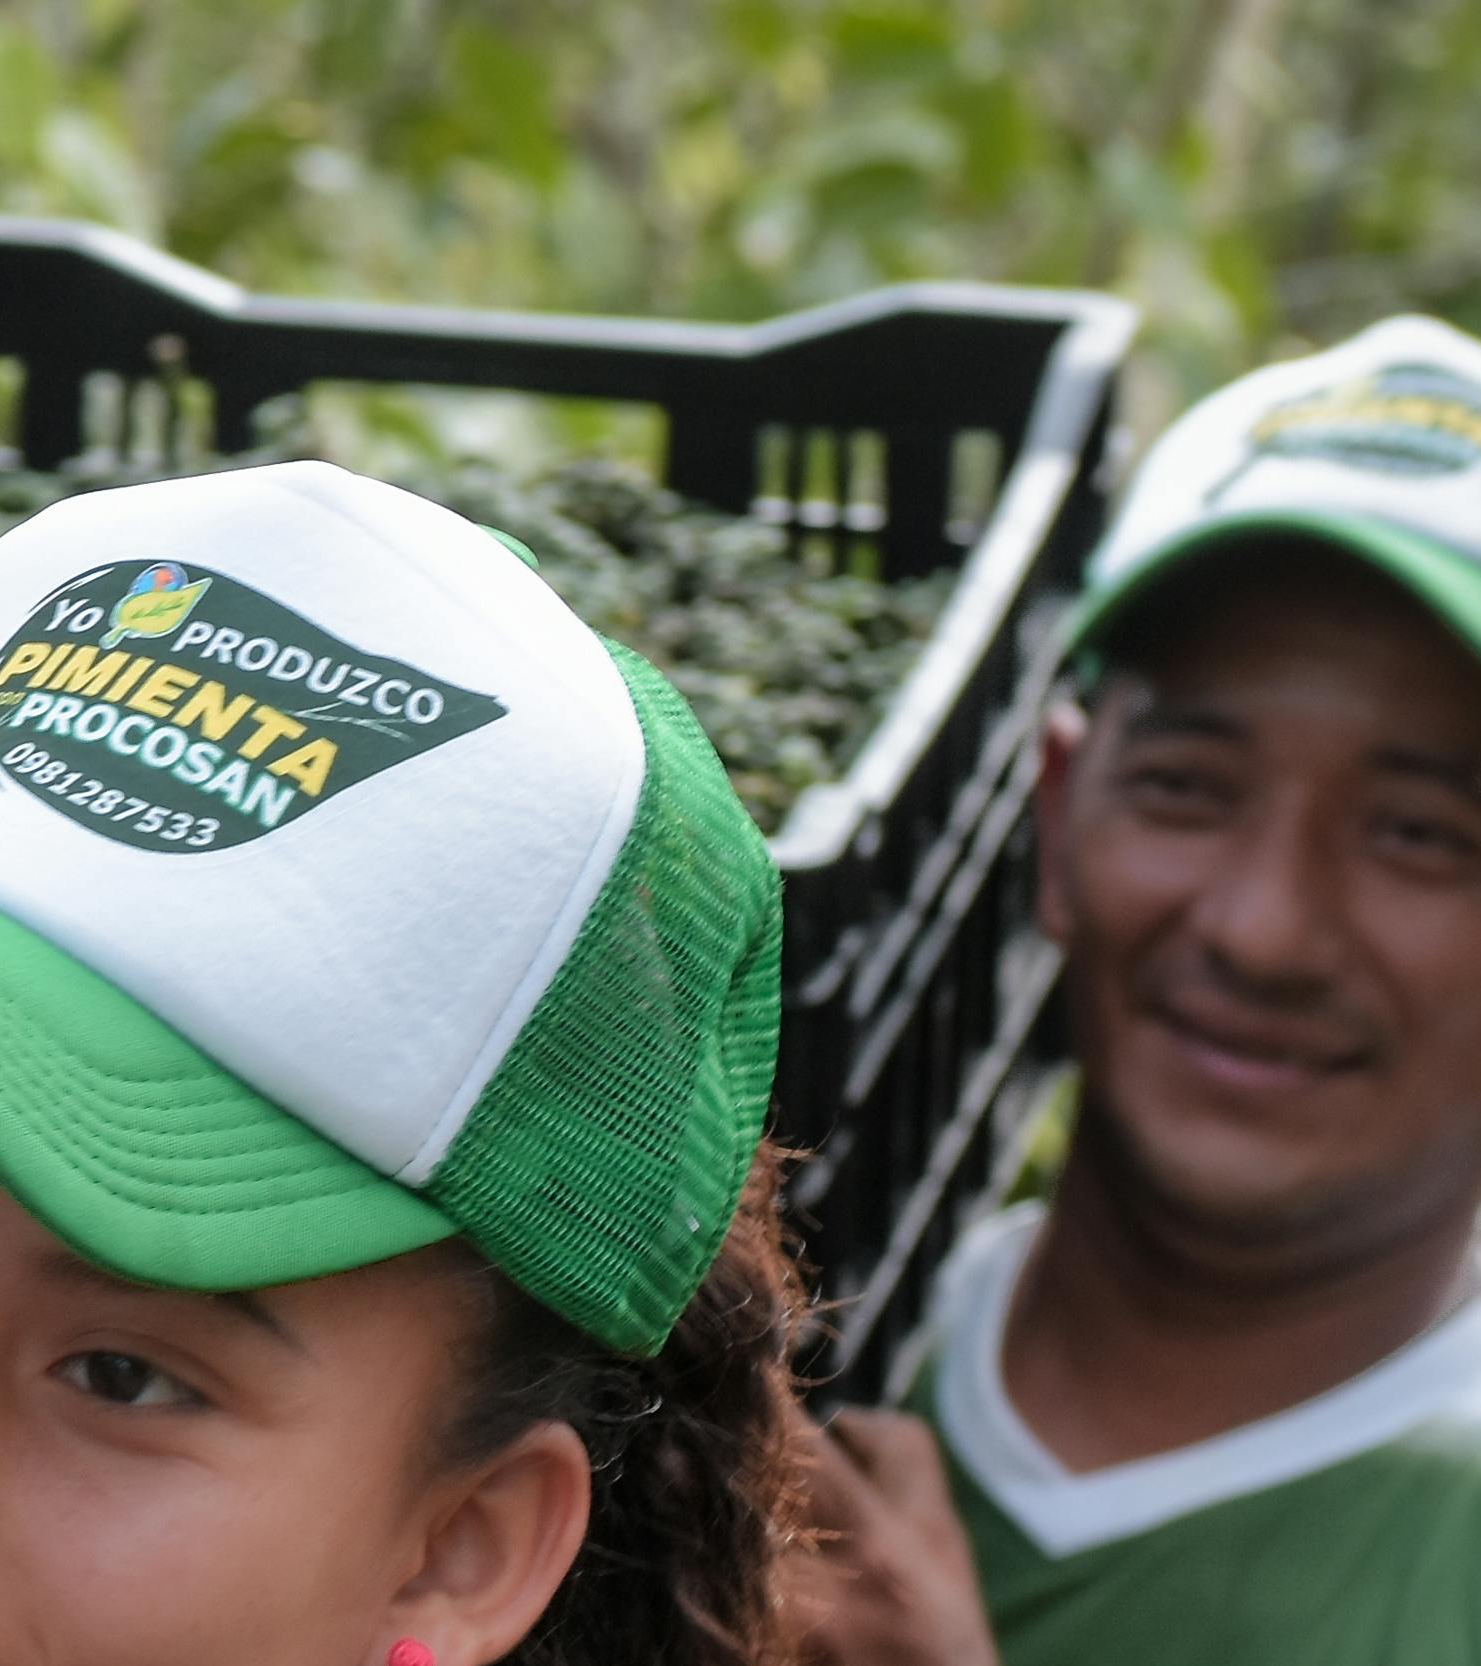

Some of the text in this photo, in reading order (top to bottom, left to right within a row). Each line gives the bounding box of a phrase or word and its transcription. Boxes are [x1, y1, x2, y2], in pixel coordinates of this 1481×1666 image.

[170, 620, 445, 725] PRODUZCO
[2, 742, 221, 847] 0981287533
[9, 692, 296, 828] PROCOSAN
